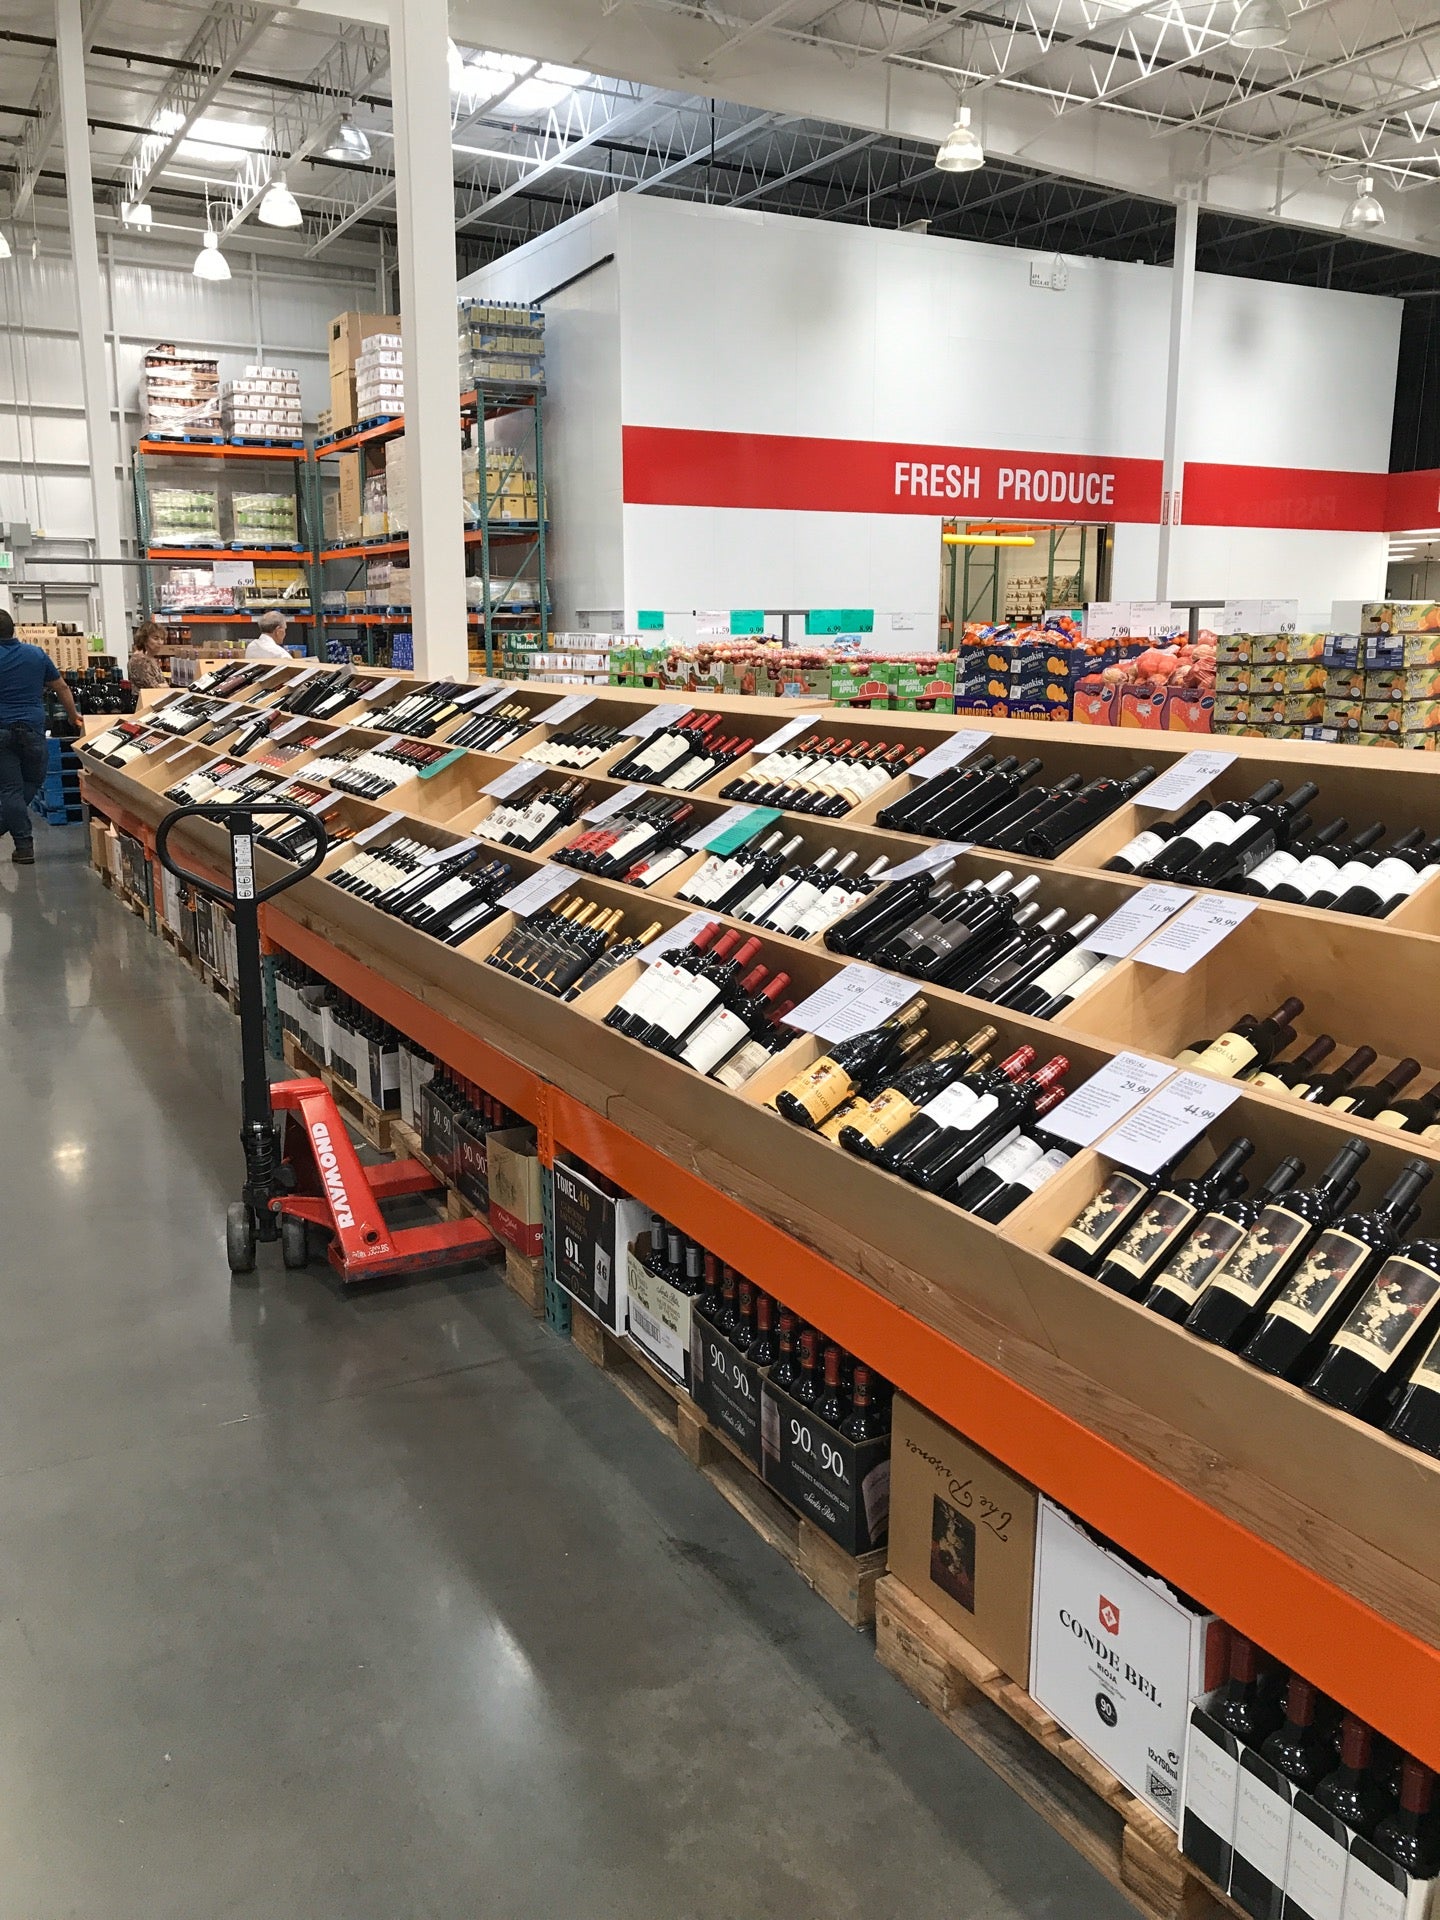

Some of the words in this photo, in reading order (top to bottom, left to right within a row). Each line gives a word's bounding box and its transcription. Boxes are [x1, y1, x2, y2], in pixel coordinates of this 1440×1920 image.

[894, 462, 980, 498] FRESH
[998, 468, 1115, 505] PRODUCE
[238, 578, 254, 586] 6.99
[711, 627, 730, 635] 11.59
[1111, 626, 1128, 636] 7.99
[1149, 626, 1170, 636] 11.99
[1280, 623, 1296, 632] 6.99
[964, 650, 985, 663] Sunkist
[1021, 651, 1045, 666] Sunkist
[965, 675, 986, 689] Sunkist
[1021, 678, 1044, 693] Sunkist
[1149, 903, 1175, 914] 11.99
[1207, 916, 1238, 928] 29.99
[1120, 1080, 1151, 1095] 29.99
[1183, 1104, 1216, 1120] 44.99
[463, 1142, 473, 1162] 90
[312, 1122, 356, 1229] RAYMOND
[556, 1172, 578, 1203] TONEL
[564, 1236, 580, 1268] 91
[597, 1259, 607, 1281] 46
[710, 1344, 725, 1374] 90
[733, 1365, 749, 1397] 90
[790, 1419, 812, 1452] 90
[821, 1443, 844, 1478] 90
[791, 1460, 813, 1482] CABERNET
[813, 1479, 840, 1503] SAUVIGNON
[905, 1438, 973, 1508] Prisoner
[803, 1492, 821, 1511] Santa
[979, 1495, 1012, 1542] The
[1059, 1609, 1120, 1672] CONDE
[1124, 1662, 1162, 1708] BEL
[1096, 1662, 1118, 1684] RIOJA
[1100, 1698, 1112, 1716] 90
[1148, 1746, 1178, 1781] 12x750ml
